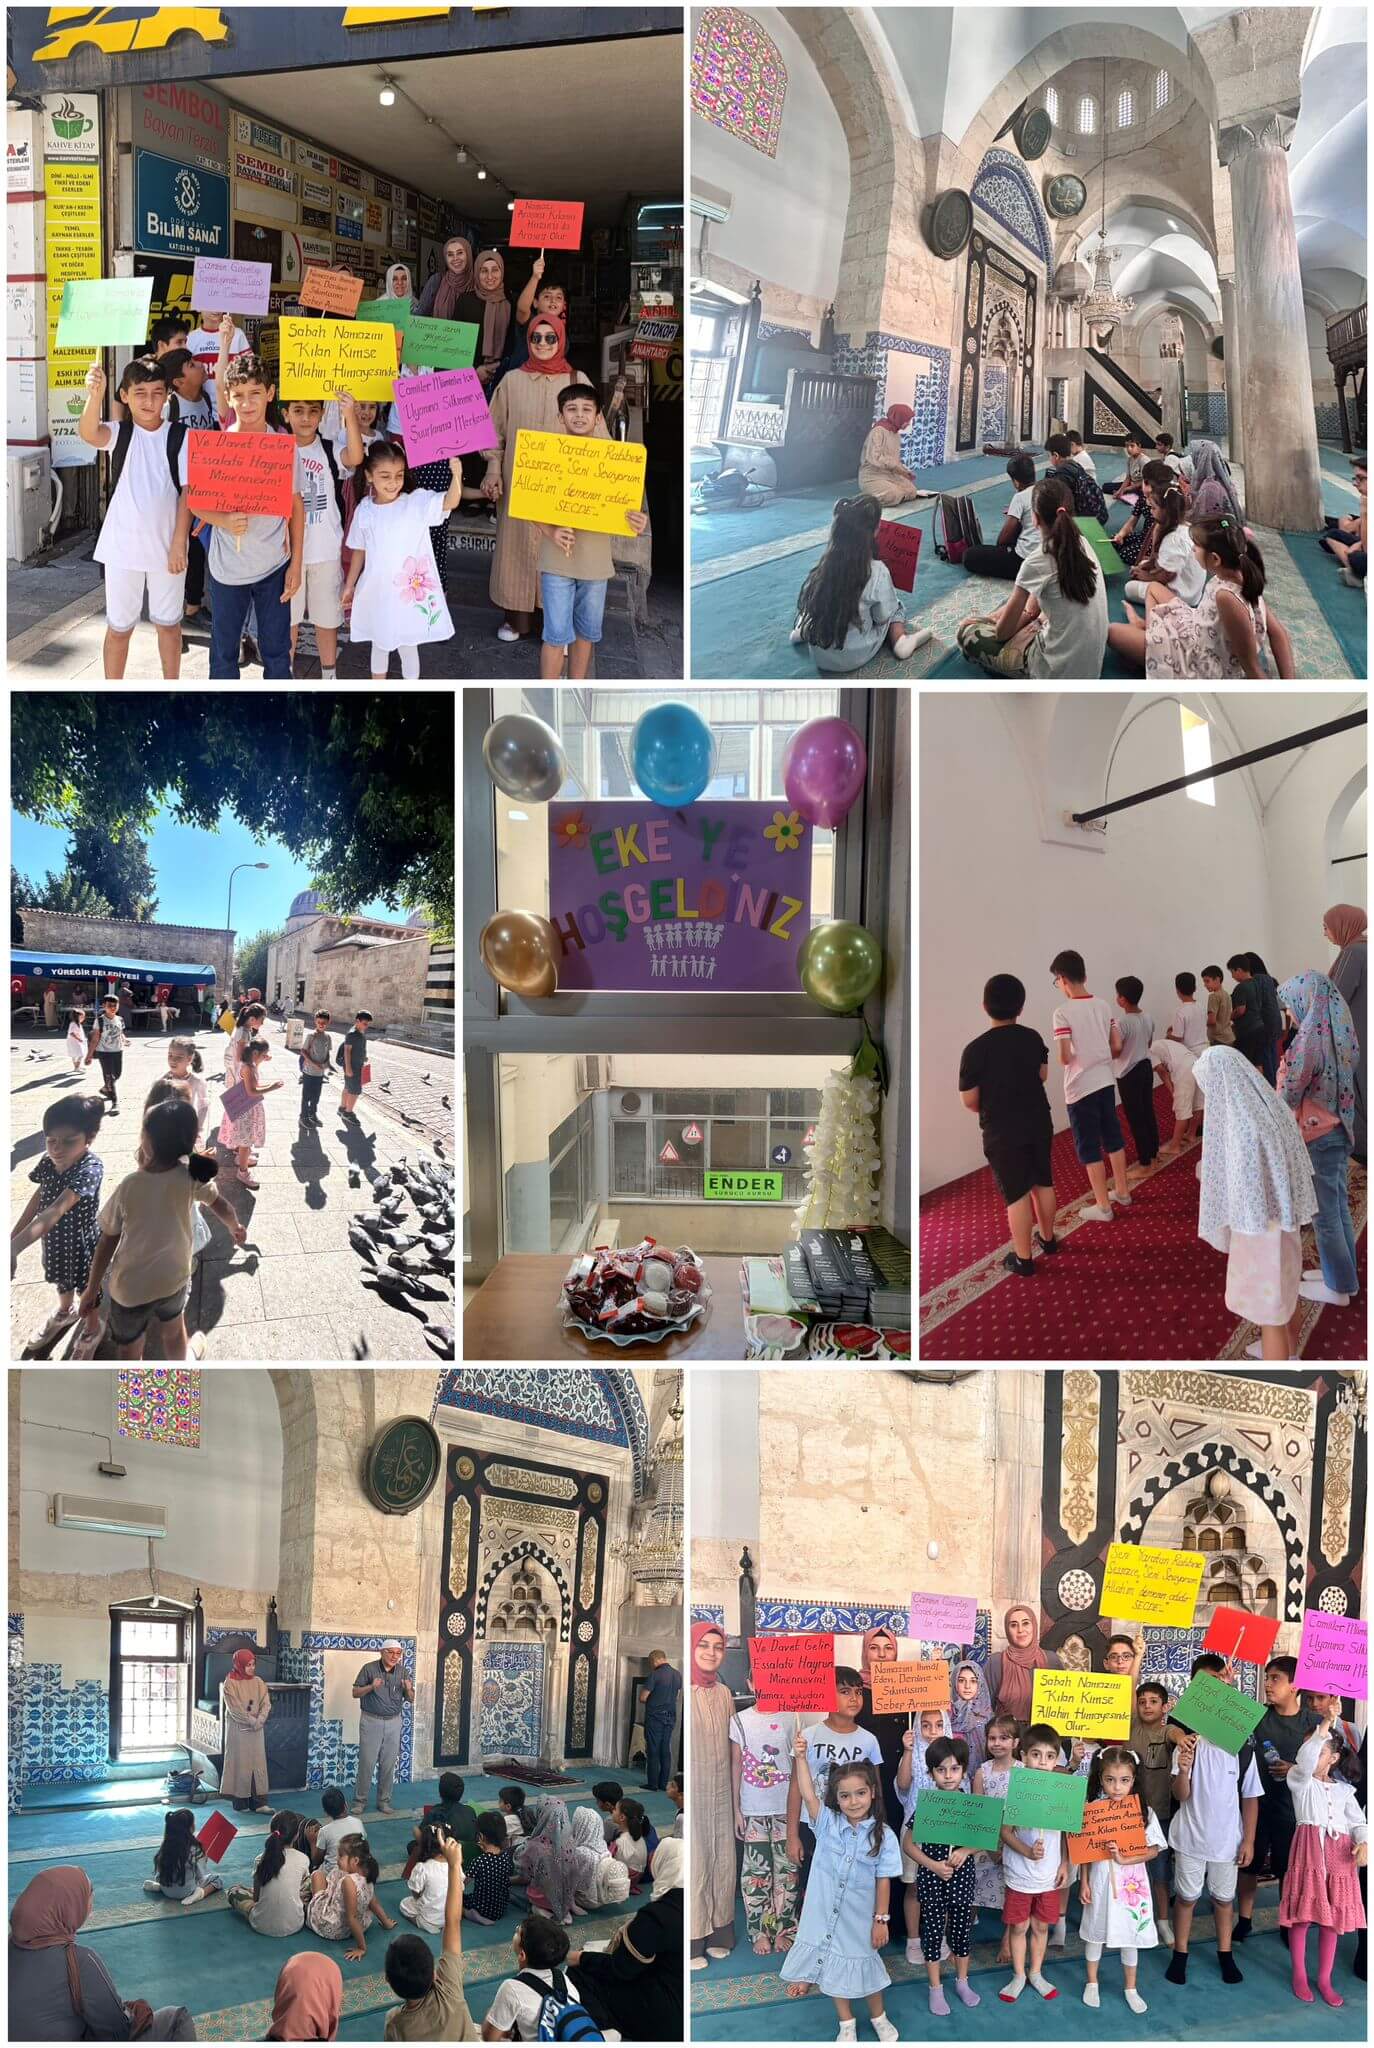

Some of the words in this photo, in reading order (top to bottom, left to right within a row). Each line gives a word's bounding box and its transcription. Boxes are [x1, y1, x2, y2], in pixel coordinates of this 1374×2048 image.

[47, 141, 73, 150] KAHVE
[236, 152, 292, 181] SEMBOL
[147, 212, 184, 239] BİLİM
[187, 226, 221, 245] SANAT
[288, 324, 326, 338] Sabah
[334, 326, 383, 341] Namazını
[638, 320, 679, 338] FOTOKOPİ
[293, 343, 331, 358] Kılan
[633, 345, 670, 360] ANAHTARCI
[53, 428, 76, 436] 7/24
[194, 433, 210, 447] Ve
[216, 434, 253, 449] Davet
[558, 438, 600, 458] Yaratan
[249, 455, 291, 476] Hayrun
[188, 485, 227, 497] Namaz
[51, 967, 90, 976] YÜREĞİR
[92, 969, 140, 980] BELEDİYESİ
[709, 1178, 775, 1190] ENDER
[1309, 1614, 1345, 1633] Camiler
[754, 1640, 766, 1653] Ve
[771, 1639, 800, 1652] Davet
[805, 1637, 833, 1652] Gelir,
[752, 1657, 793, 1669] Essalatü
[799, 1656, 834, 1674] Hayrun
[899, 1674, 931, 1683] Derdine
[1040, 1674, 1071, 1687] Sabah
[755, 1688, 784, 1700] Namaz
[1042, 1690, 1074, 1703] Kılan
[875, 1697, 904, 1711] Sebep
[814, 1744, 862, 1760] TRAP
[920, 1792, 957, 1805] Namaz
[1108, 1800, 1133, 1812] Kılan
[1098, 1825, 1117, 1836] Kılan
